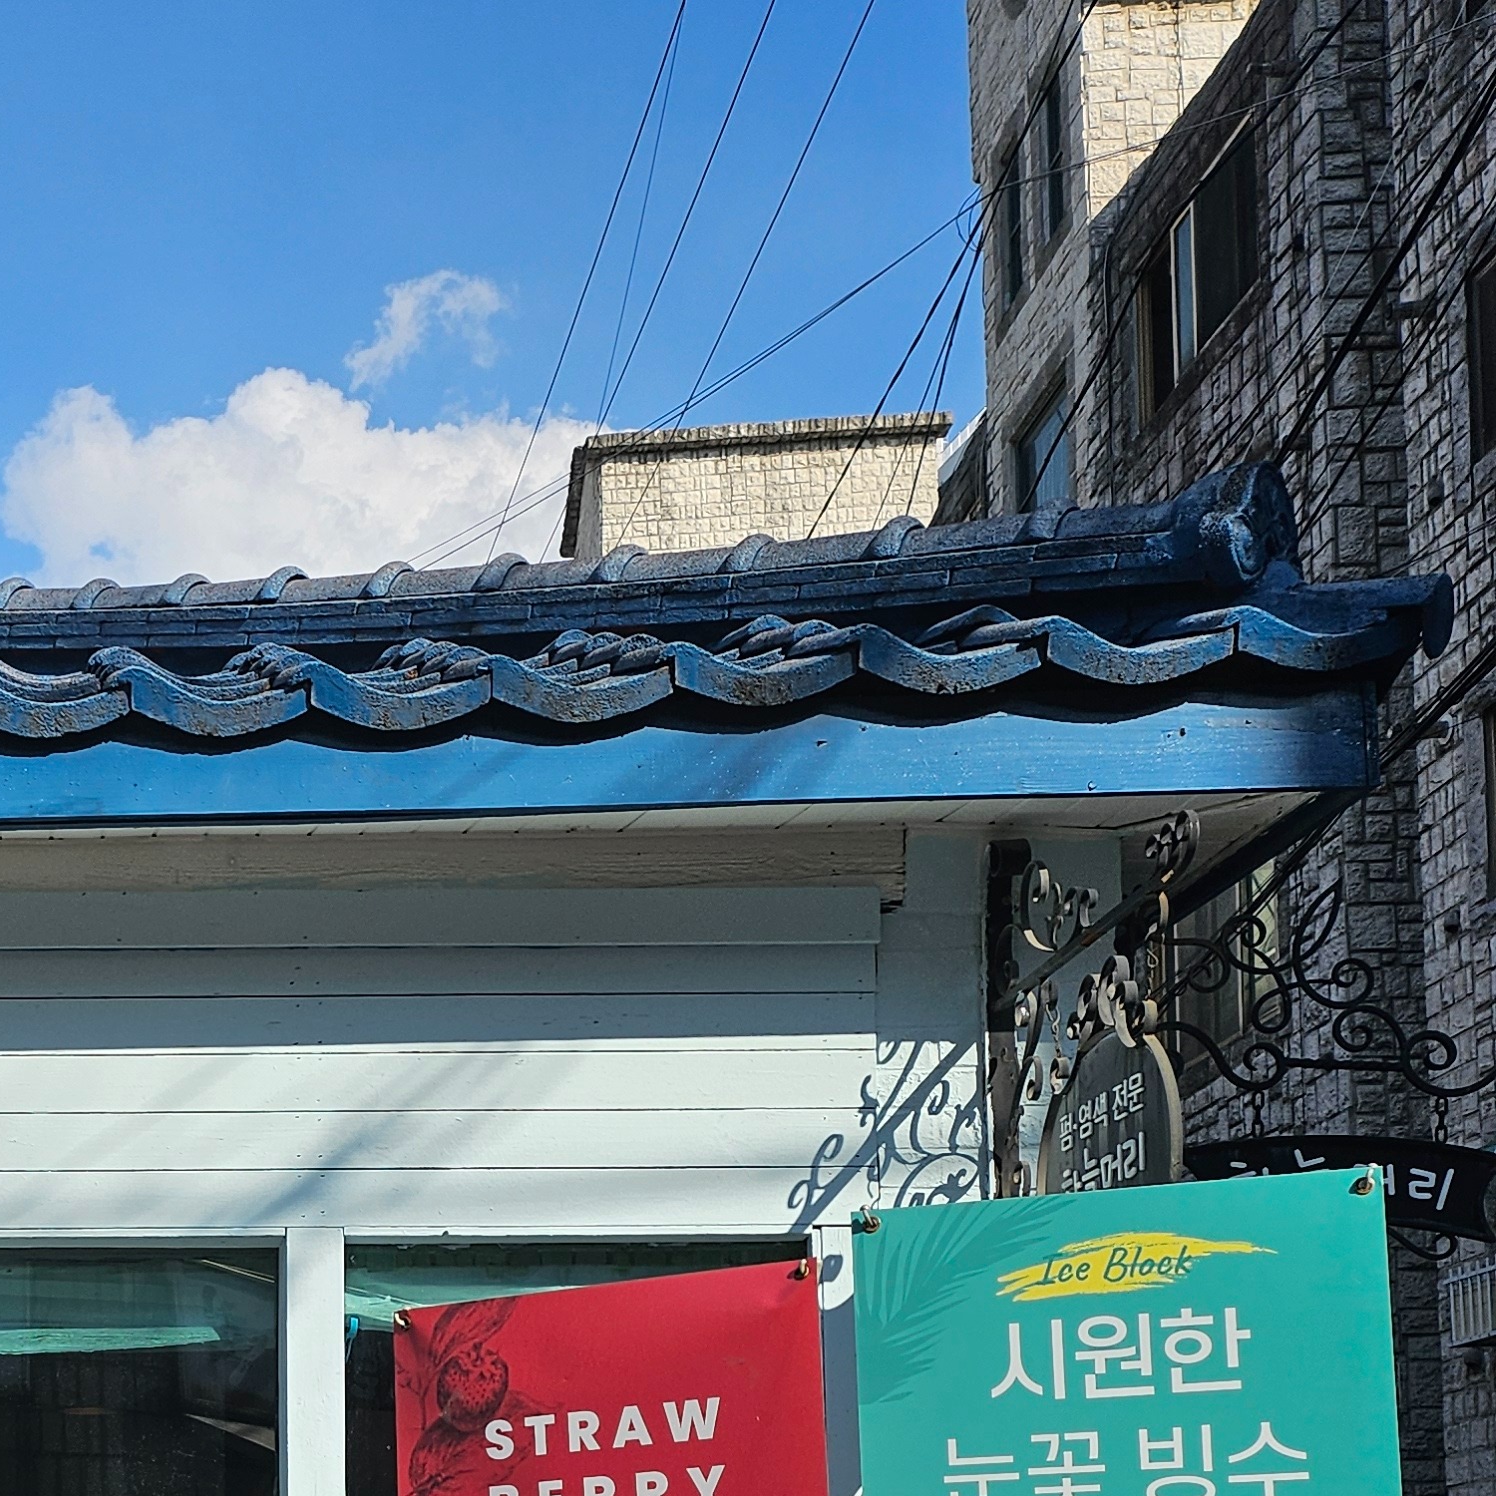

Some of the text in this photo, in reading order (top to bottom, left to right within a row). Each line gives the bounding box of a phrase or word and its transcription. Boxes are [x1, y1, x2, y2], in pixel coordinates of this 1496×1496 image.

[1112, 1072, 1145, 1121] 전문
[1039, 1244, 1194, 1285] Ice Block
[990, 1306, 1252, 1401] 시원한
[484, 1397, 721, 1460] STRAW
